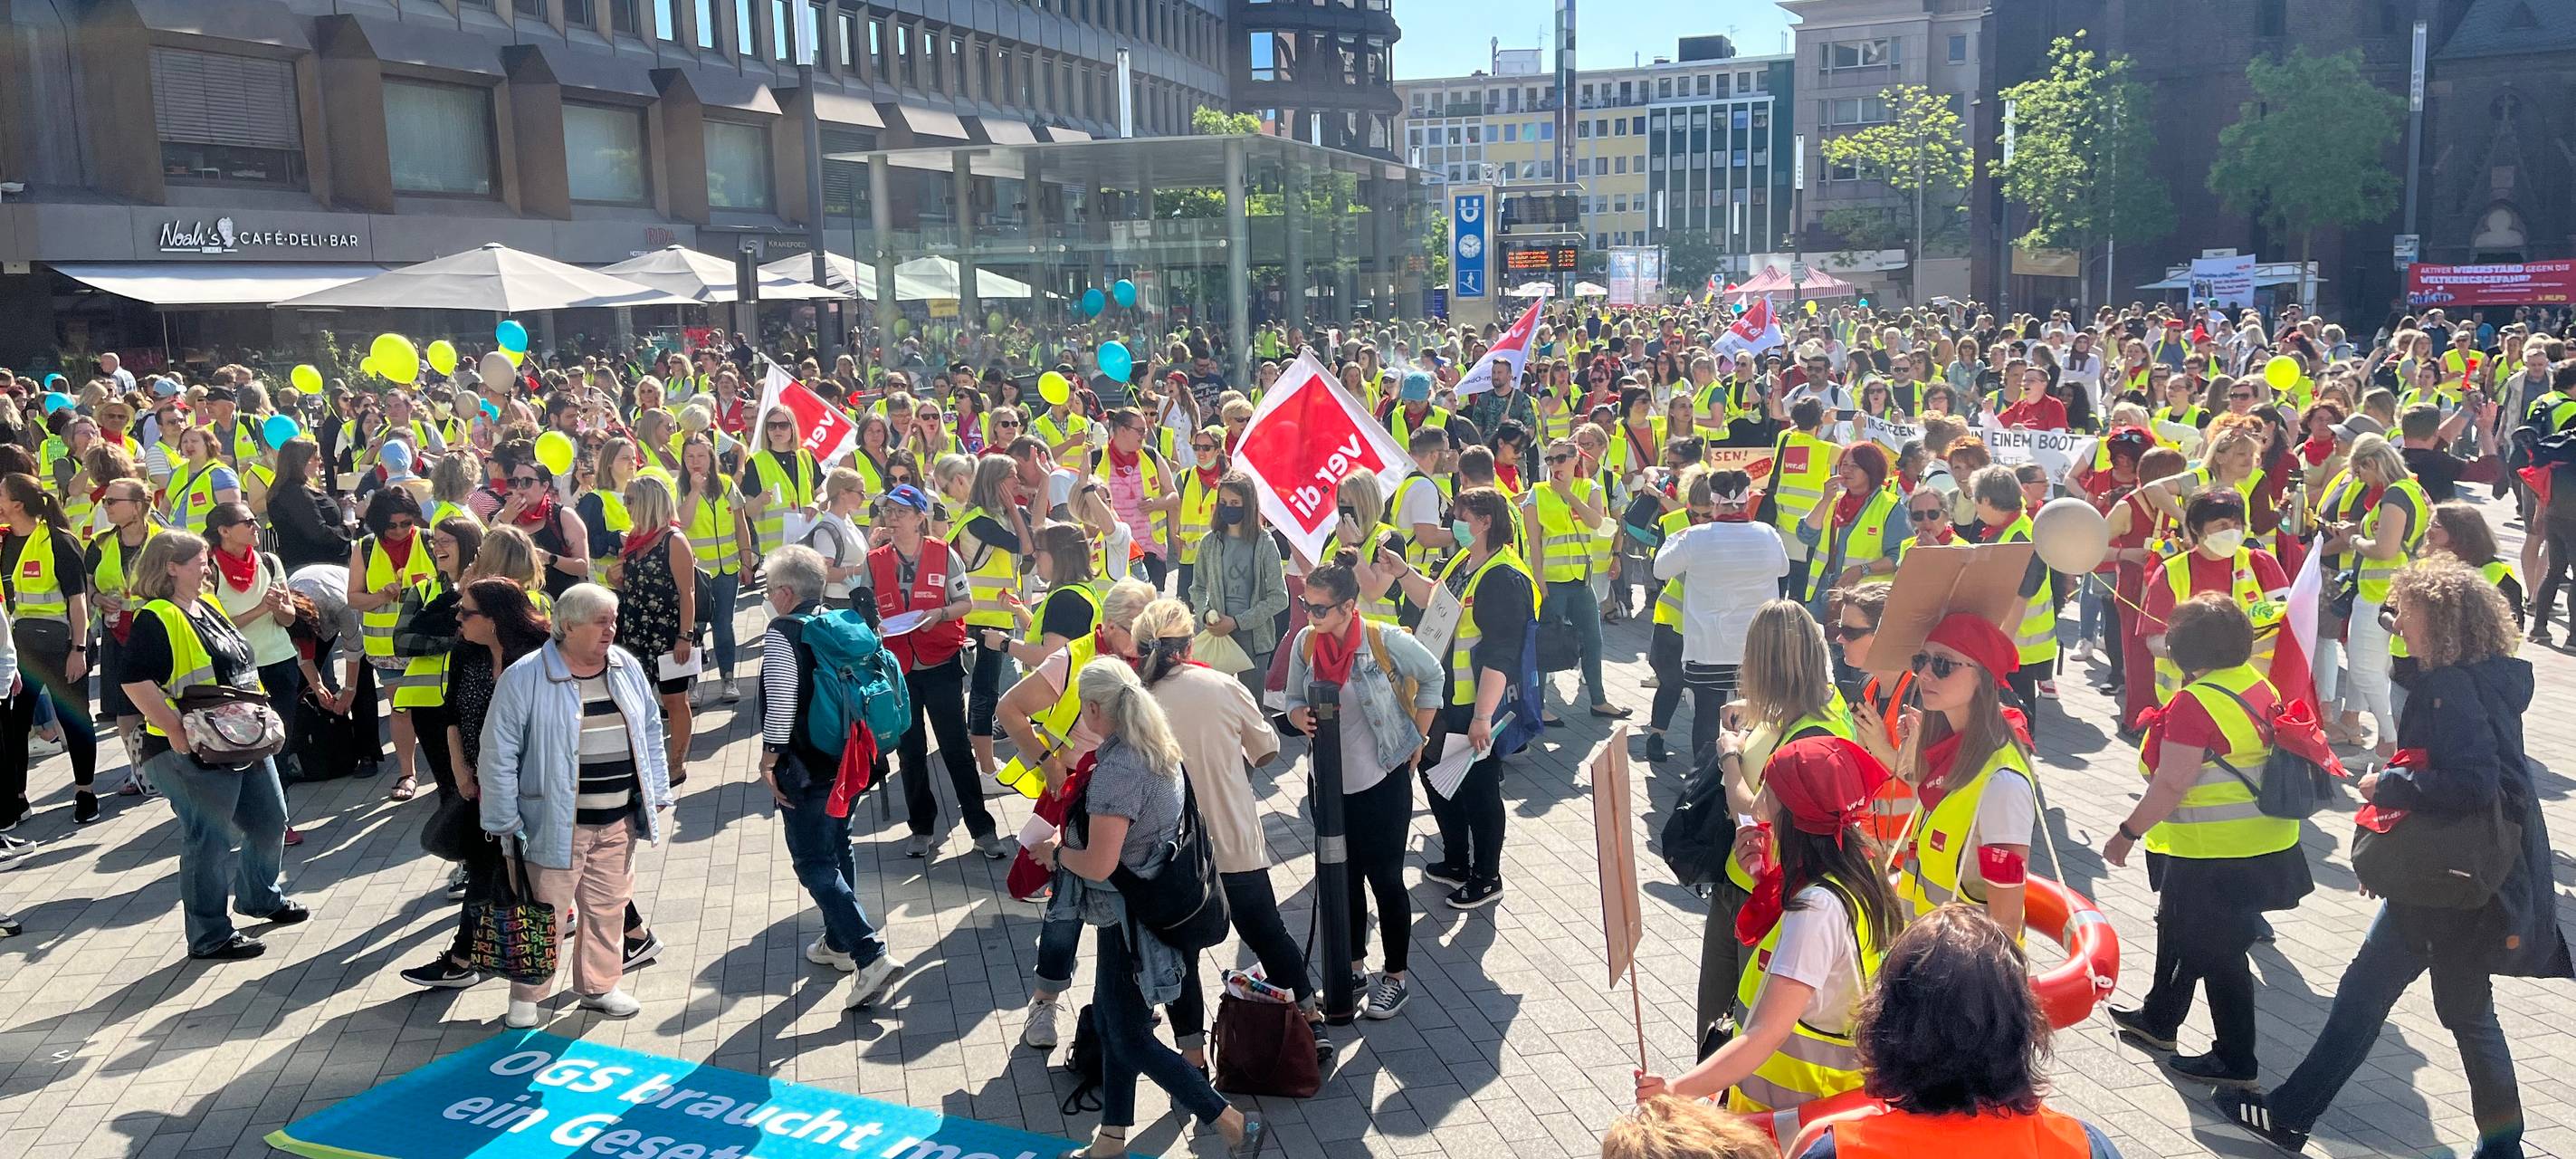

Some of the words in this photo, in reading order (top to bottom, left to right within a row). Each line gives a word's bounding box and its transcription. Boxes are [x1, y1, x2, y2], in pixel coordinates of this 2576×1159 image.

[159, 219, 220, 246] Noah's
[2453, 264, 2524, 273] WIDERSTAND
[2525, 264, 2553, 273] GEGEN
[1879, 421, 1917, 436] SITZEN
[1991, 432, 2032, 449] EINEM
[2038, 434, 2082, 452] BOOT
[443, 1095, 549, 1134] ein
[490, 1050, 634, 1092] OGS
[618, 1073, 884, 1152] braucht
